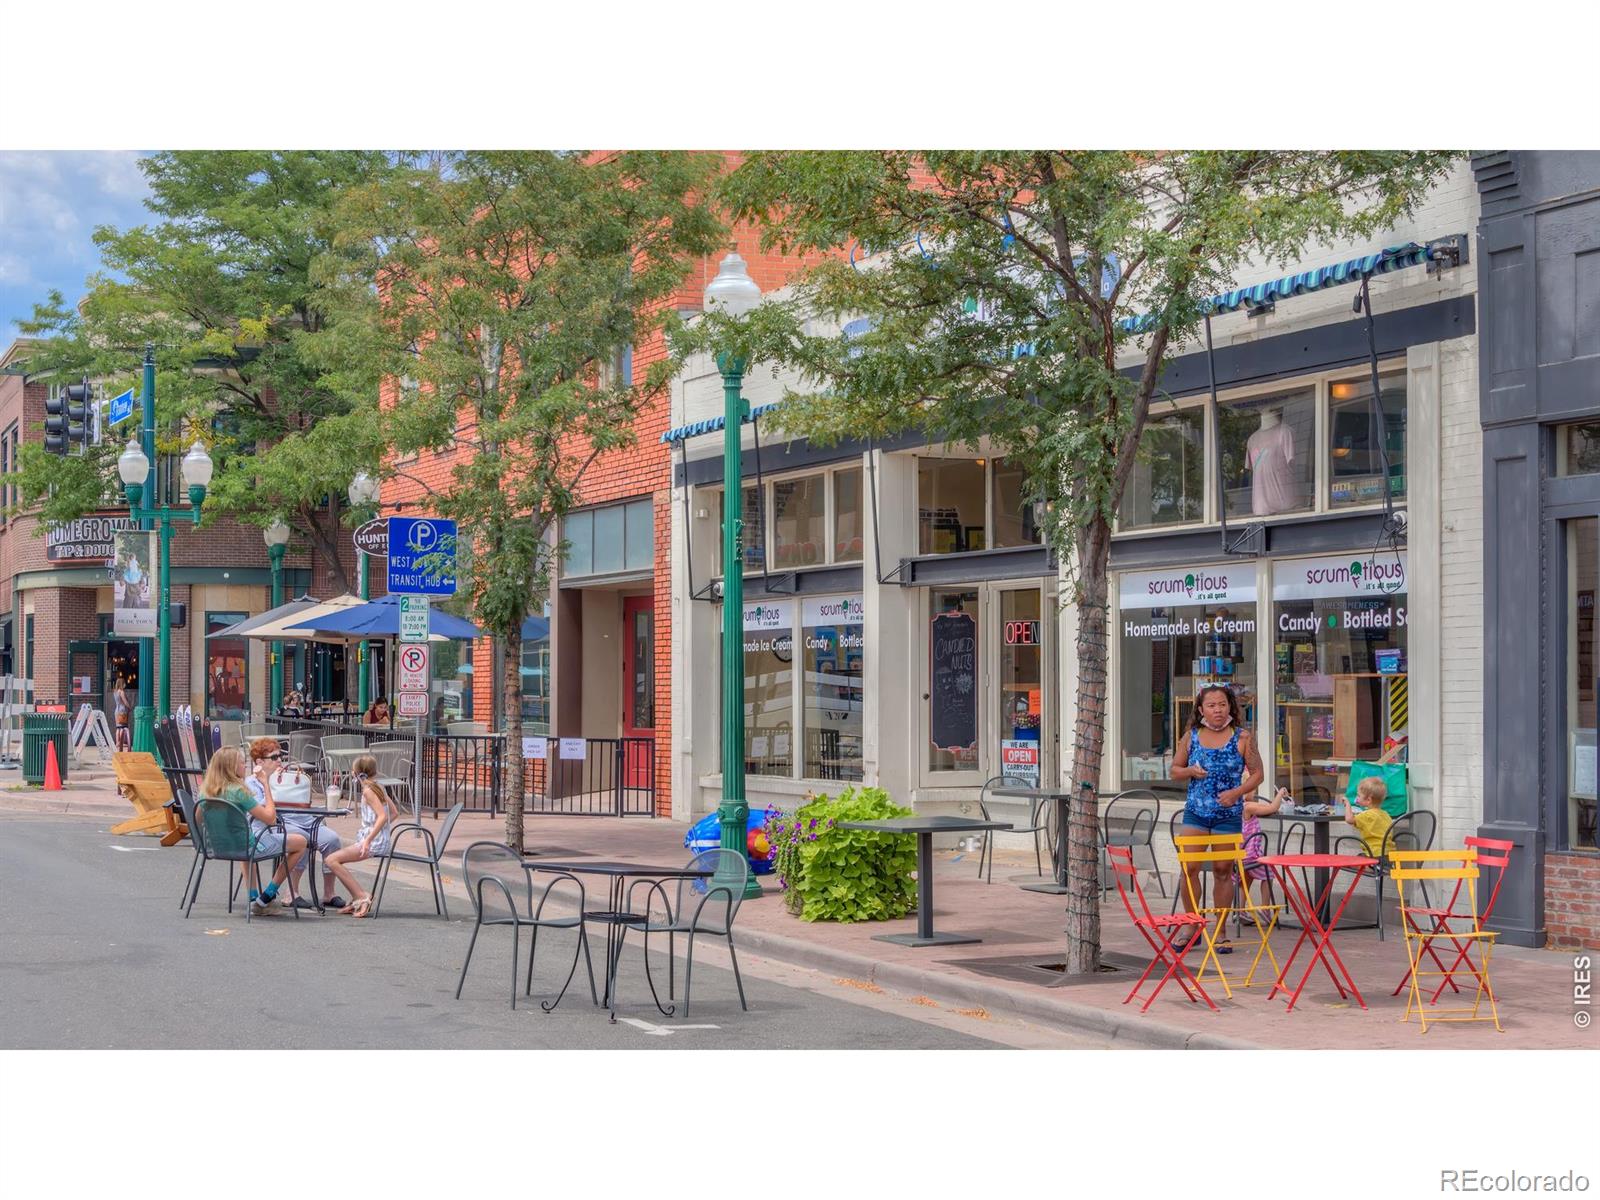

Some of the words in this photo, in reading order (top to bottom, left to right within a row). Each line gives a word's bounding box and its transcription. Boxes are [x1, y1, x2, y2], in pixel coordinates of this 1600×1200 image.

[55, 545, 72, 557] TAP
[74, 544, 83, 557] &
[391, 556, 410, 567] WEST
[391, 574, 421, 586] TRANSIT
[425, 574, 441, 587] HUB
[1386, 580, 1400, 591] good
[1214, 592, 1227, 600] good
[402, 598, 409, 611] 2
[1124, 618, 1190, 637] Homemade
[1193, 618, 1210, 634] Ice
[1214, 616, 1256, 633] Cream
[1279, 611, 1322, 634] Candy
[1343, 607, 1392, 629] Bottled
[1005, 622, 1041, 644] OPEN
[760, 639, 770, 651] Ice
[771, 638, 792, 651] Cream
[805, 636, 829, 652] Candy
[951, 654, 973, 670] NUTS
[1008, 750, 1032, 762] OPEN
[1006, 763, 1034, 771] CARRY-OUT
